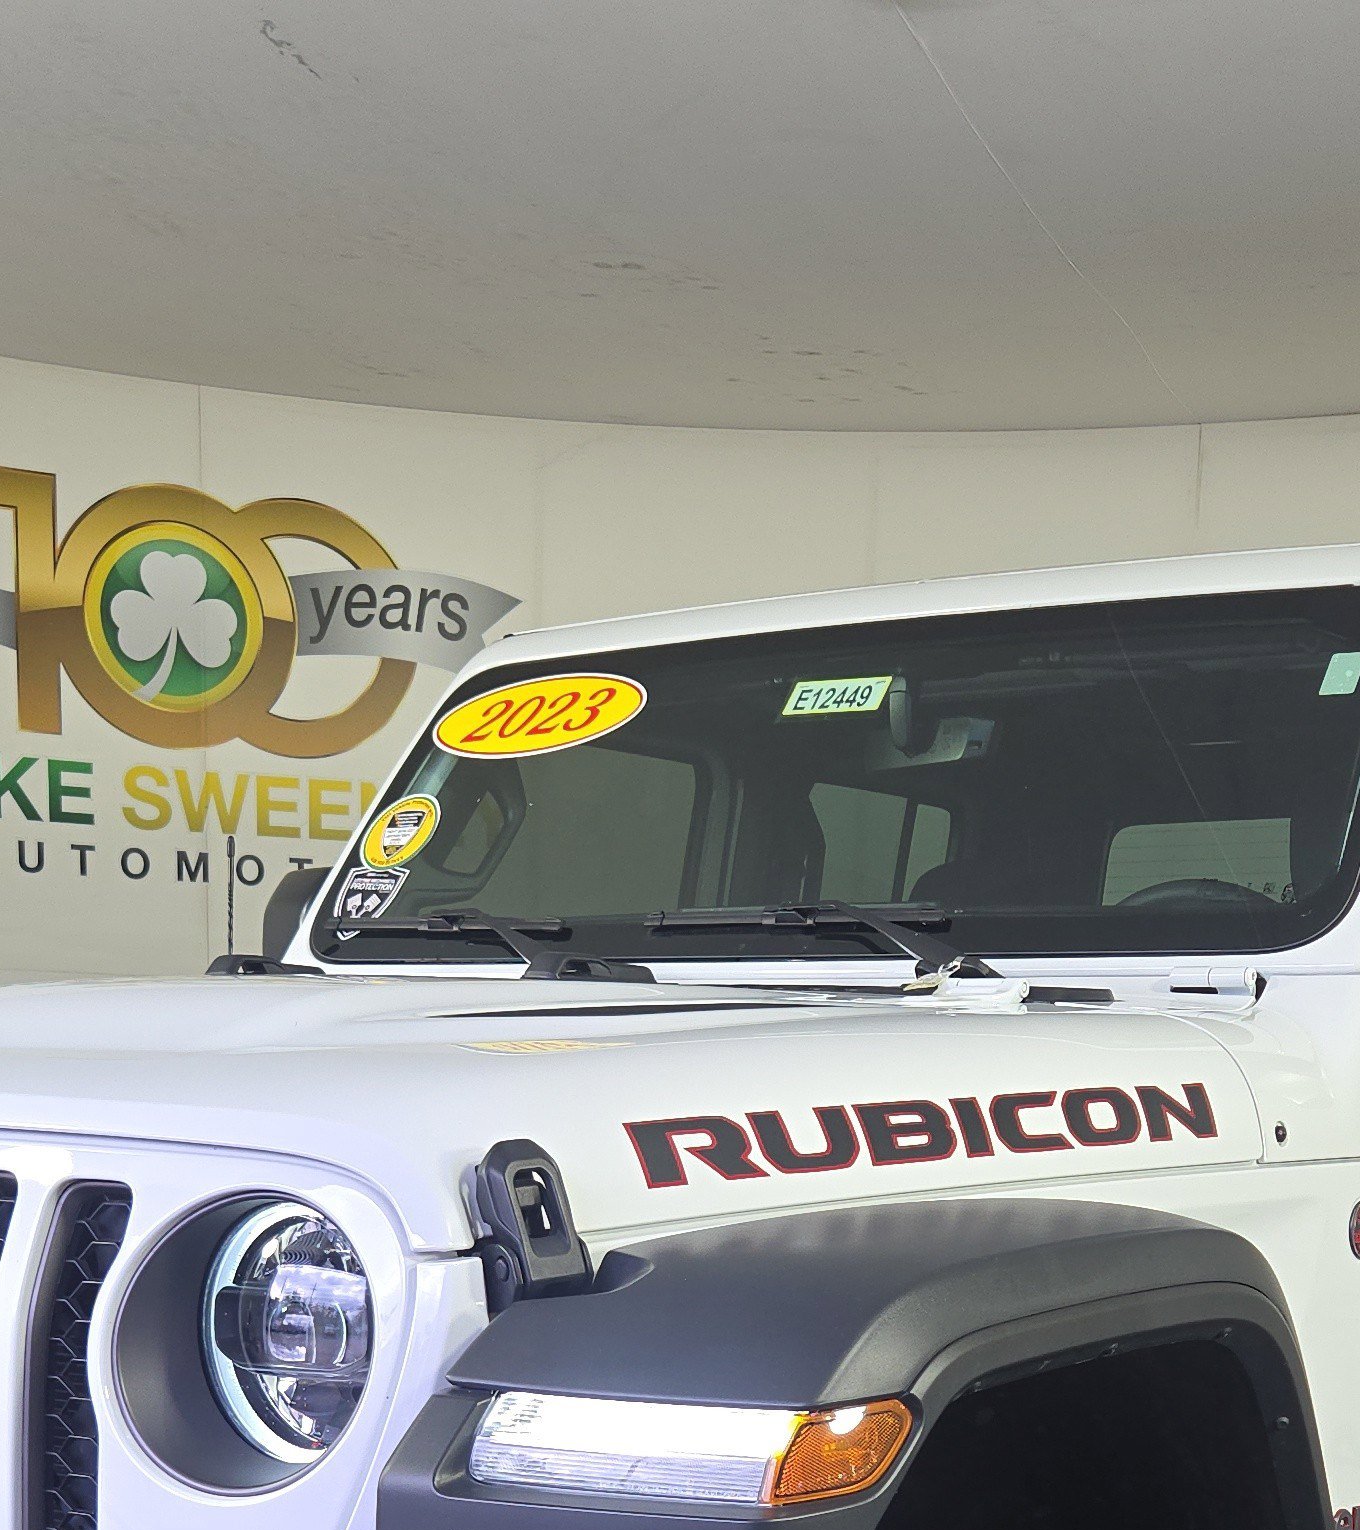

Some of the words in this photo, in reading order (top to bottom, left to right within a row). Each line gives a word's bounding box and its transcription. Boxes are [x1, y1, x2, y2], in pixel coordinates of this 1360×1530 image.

[309, 576, 469, 645] years
[459, 687, 617, 743] 2023
[793, 685, 873, 710] E12449
[122, 765, 378, 842] SWEE
[622, 1083, 1218, 1189] RUBICON
